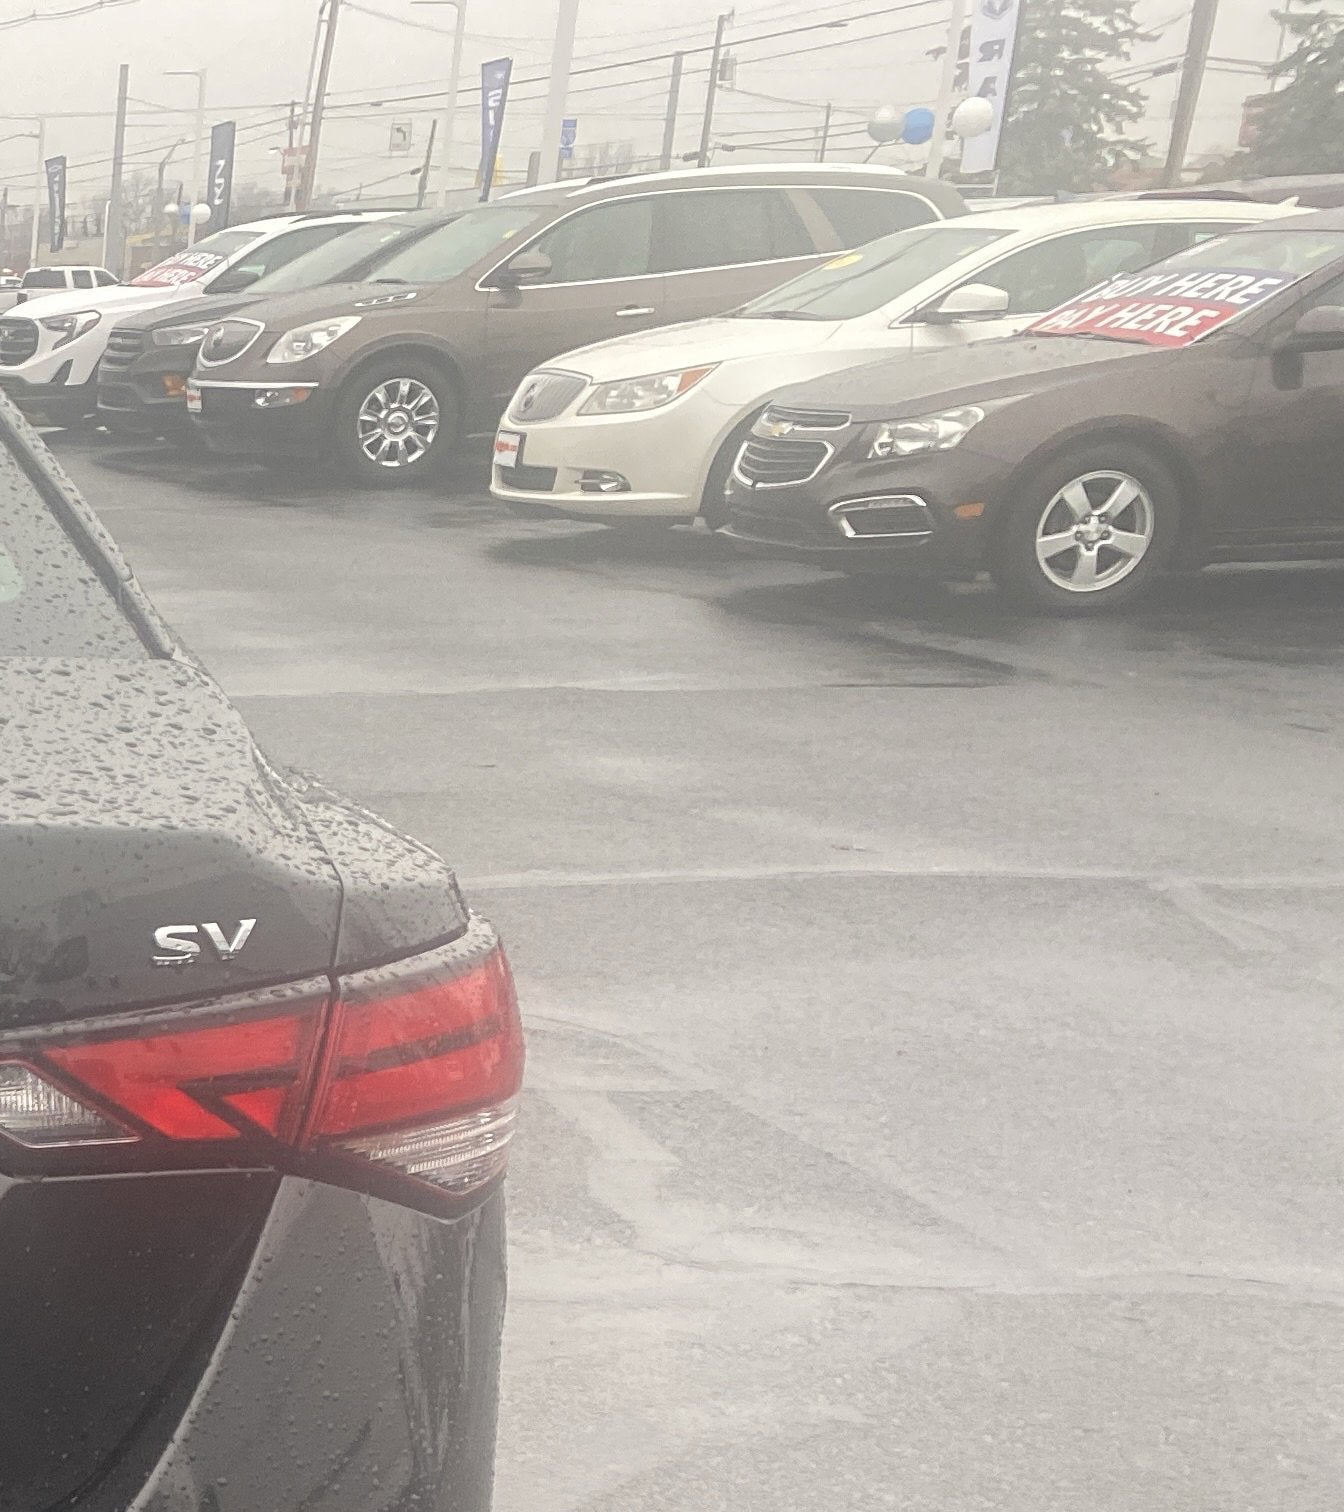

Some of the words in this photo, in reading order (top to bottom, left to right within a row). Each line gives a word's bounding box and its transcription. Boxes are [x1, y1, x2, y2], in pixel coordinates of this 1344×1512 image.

[1152, 272, 1283, 304] HERE
[1034, 303, 1121, 330] PAY
[1093, 302, 1221, 338] HERE
[152, 918, 257, 961] SV
